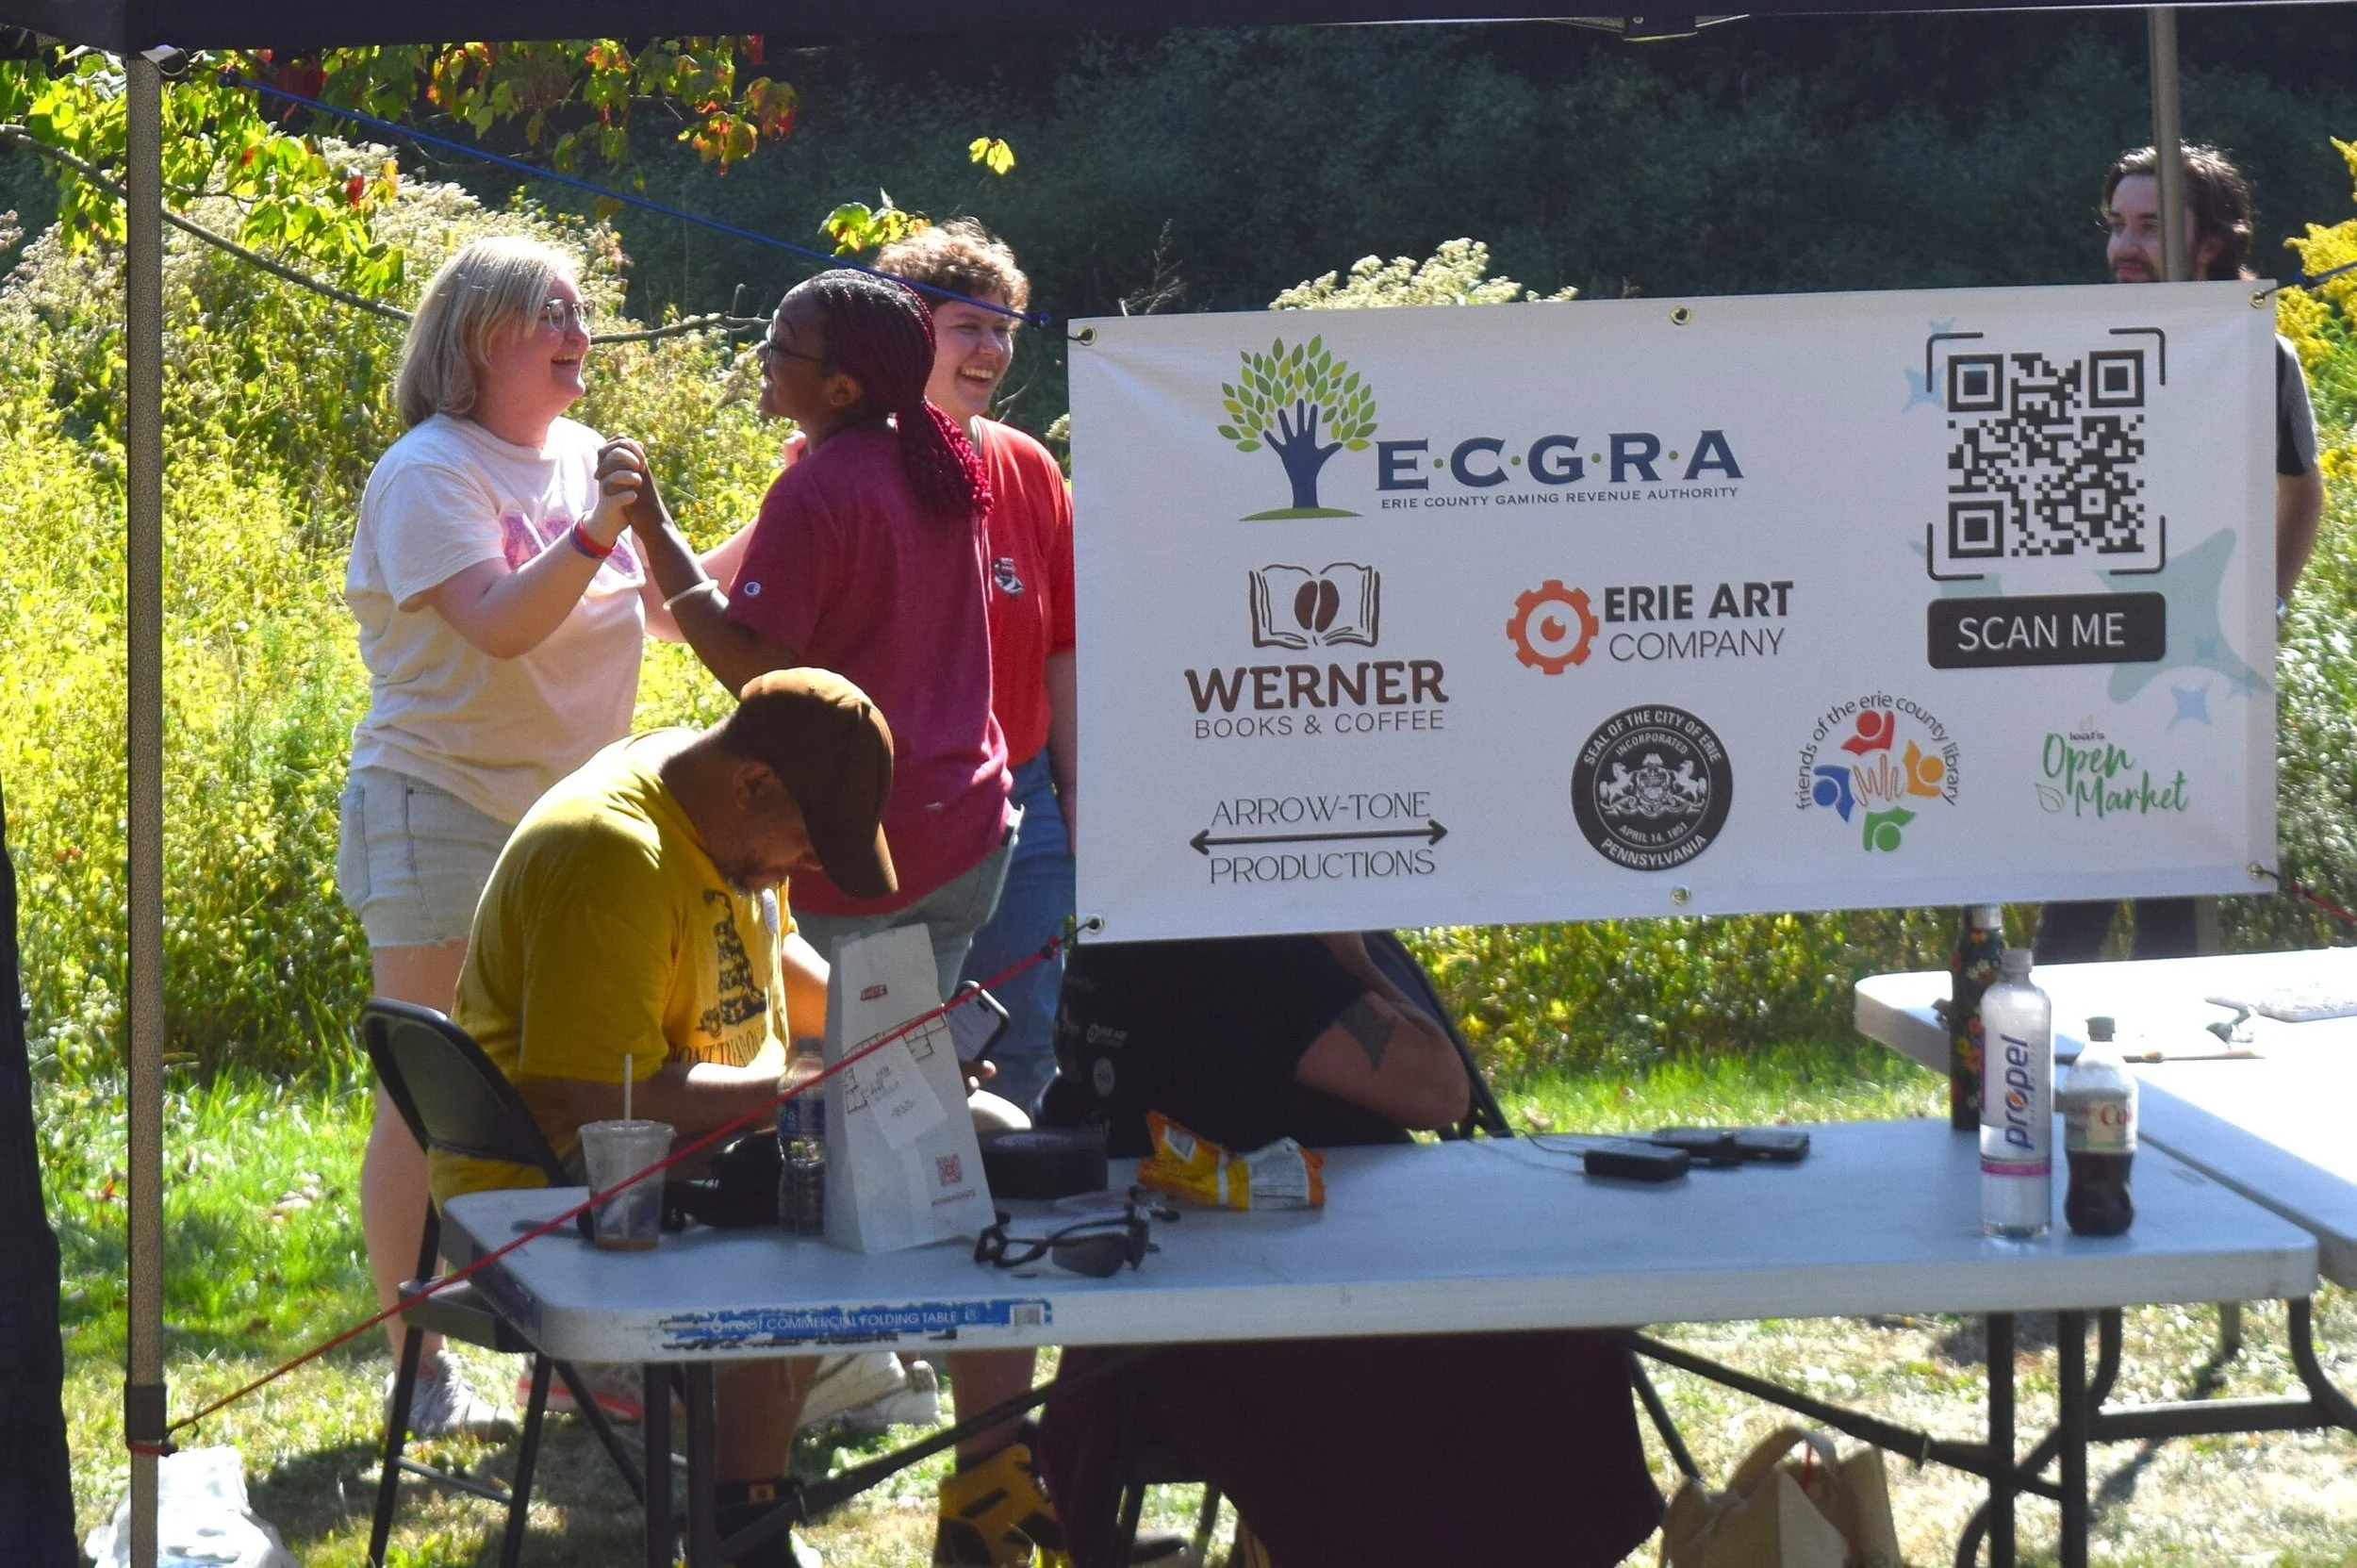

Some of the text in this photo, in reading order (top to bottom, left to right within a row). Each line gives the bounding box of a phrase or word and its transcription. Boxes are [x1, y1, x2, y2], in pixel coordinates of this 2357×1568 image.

[1381, 487, 1738, 509] ERIE COUNTY GAMING REVENUE AUTHORITY
[1604, 580, 1794, 623] ERIE ART
[1608, 627, 1786, 662] COMPANY
[1957, 613, 2126, 652] SCAN ME
[1184, 659, 1449, 714] WERNER
[1195, 709, 1444, 739] BOOKS & COFFEE
[1583, 710, 1722, 766] SEAL OF THE CITY OF ERIE
[1615, 733, 1689, 756] INCORPORATED
[1796, 690, 1961, 811] friends of the erie county library
[2043, 733, 2136, 796] Open
[1211, 791, 1431, 827] ARROW-TONE
[2074, 769, 2189, 818] Market
[1601, 834, 1707, 867] PENNSYLVANIA
[1619, 824, 1648, 843] APRIL
[1211, 849, 1436, 884] PRODUCTIONS
[2000, 1033, 2035, 1151] propel
[860, 1312, 920, 1327] FOLDING
[923, 1311, 958, 1325] TABLE
